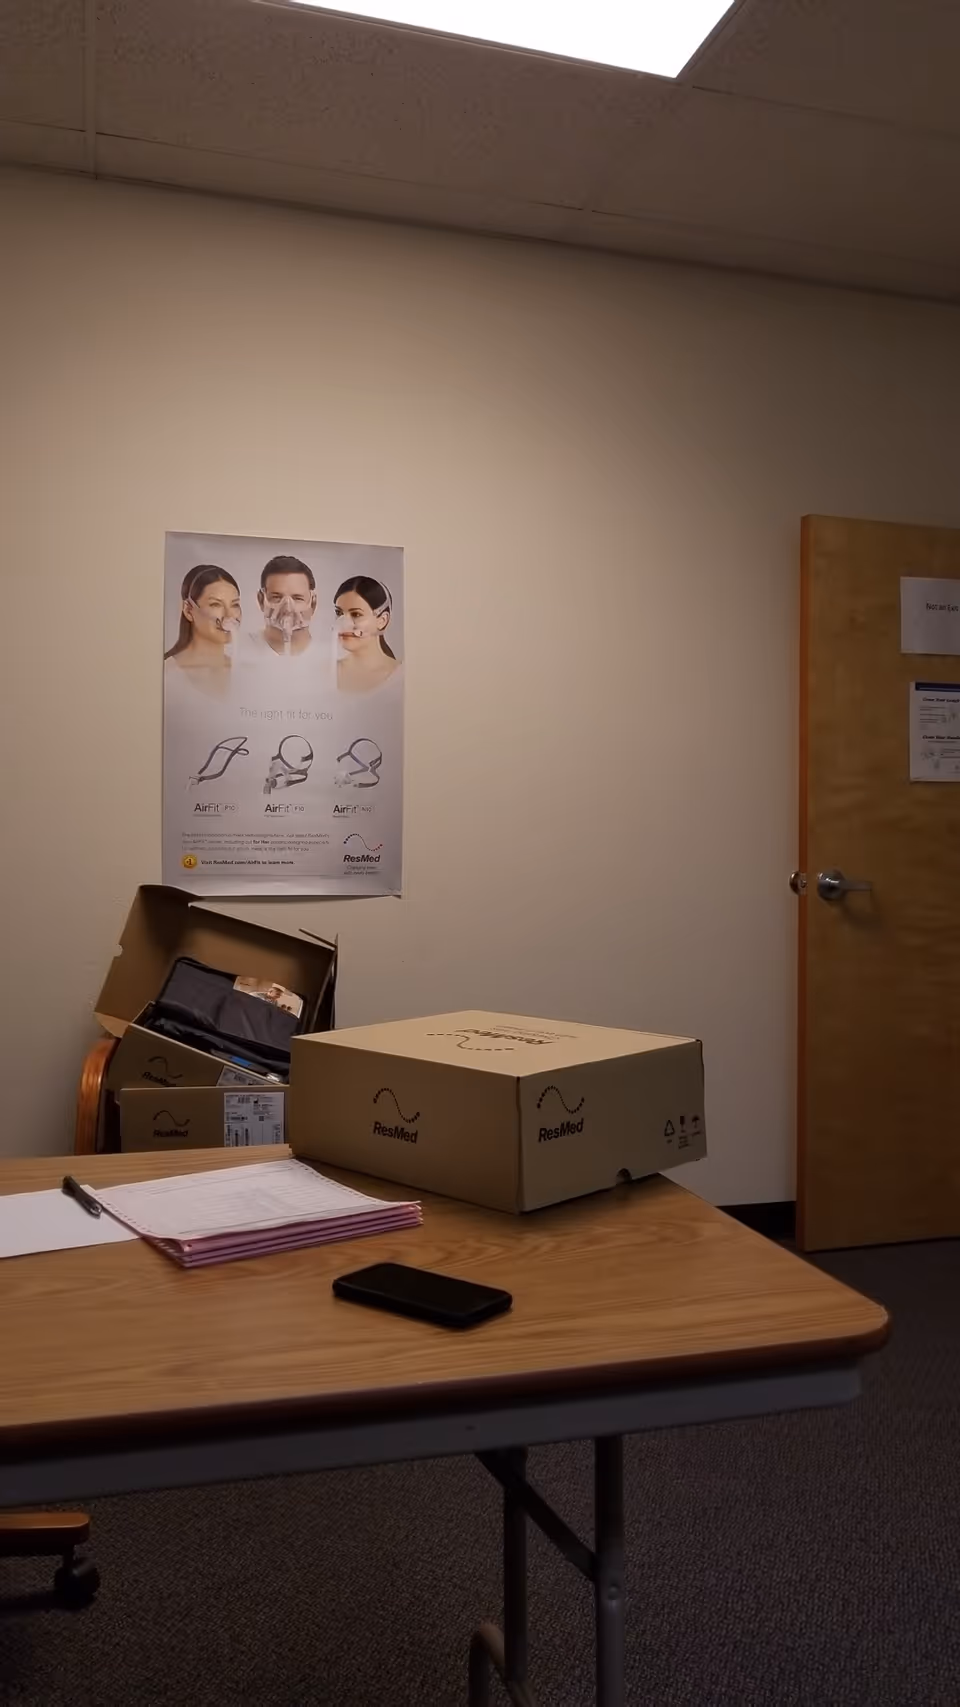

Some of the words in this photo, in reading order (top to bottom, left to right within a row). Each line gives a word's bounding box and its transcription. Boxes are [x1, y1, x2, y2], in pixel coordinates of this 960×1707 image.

[239, 706, 258, 718] The
[260, 708, 283, 721] right
[299, 708, 312, 720] for
[314, 711, 334, 721] you
[343, 854, 381, 863] ResMed
[372, 1120, 419, 1144] ResMed
[538, 1117, 584, 1143] ResMed
